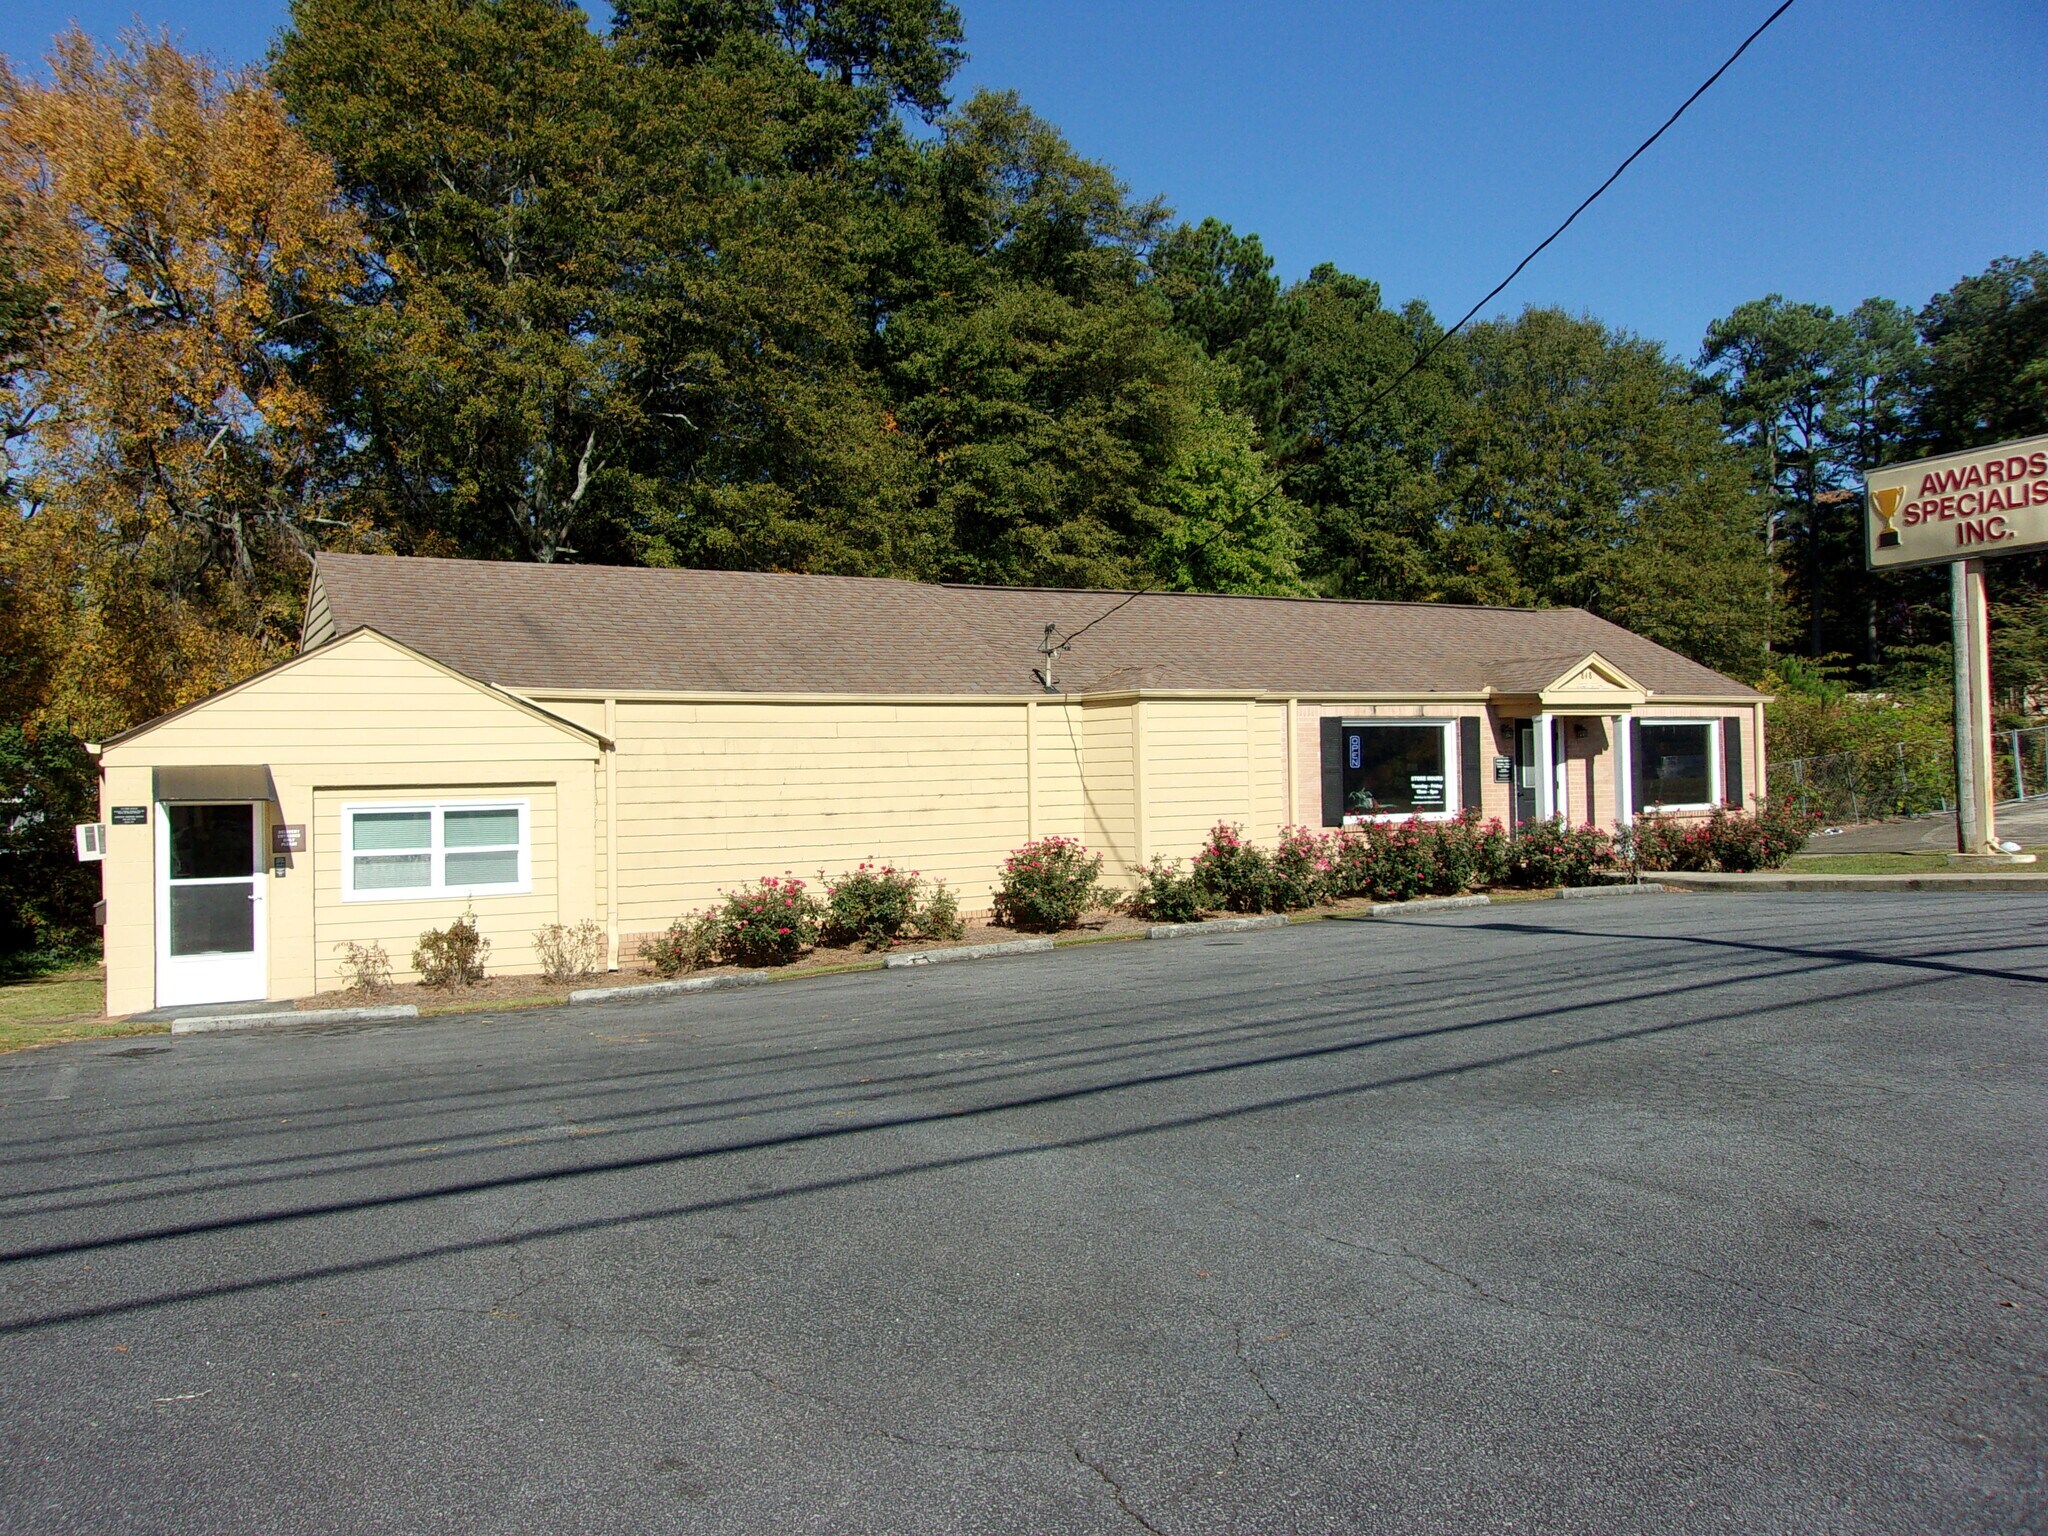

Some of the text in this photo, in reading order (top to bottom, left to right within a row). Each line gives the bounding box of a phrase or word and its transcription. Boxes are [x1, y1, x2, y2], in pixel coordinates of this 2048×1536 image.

[1919, 452, 2048, 498] AWARDS
[1903, 480, 2048, 527] SPECIALIS
[1957, 516, 2016, 546] INC.
